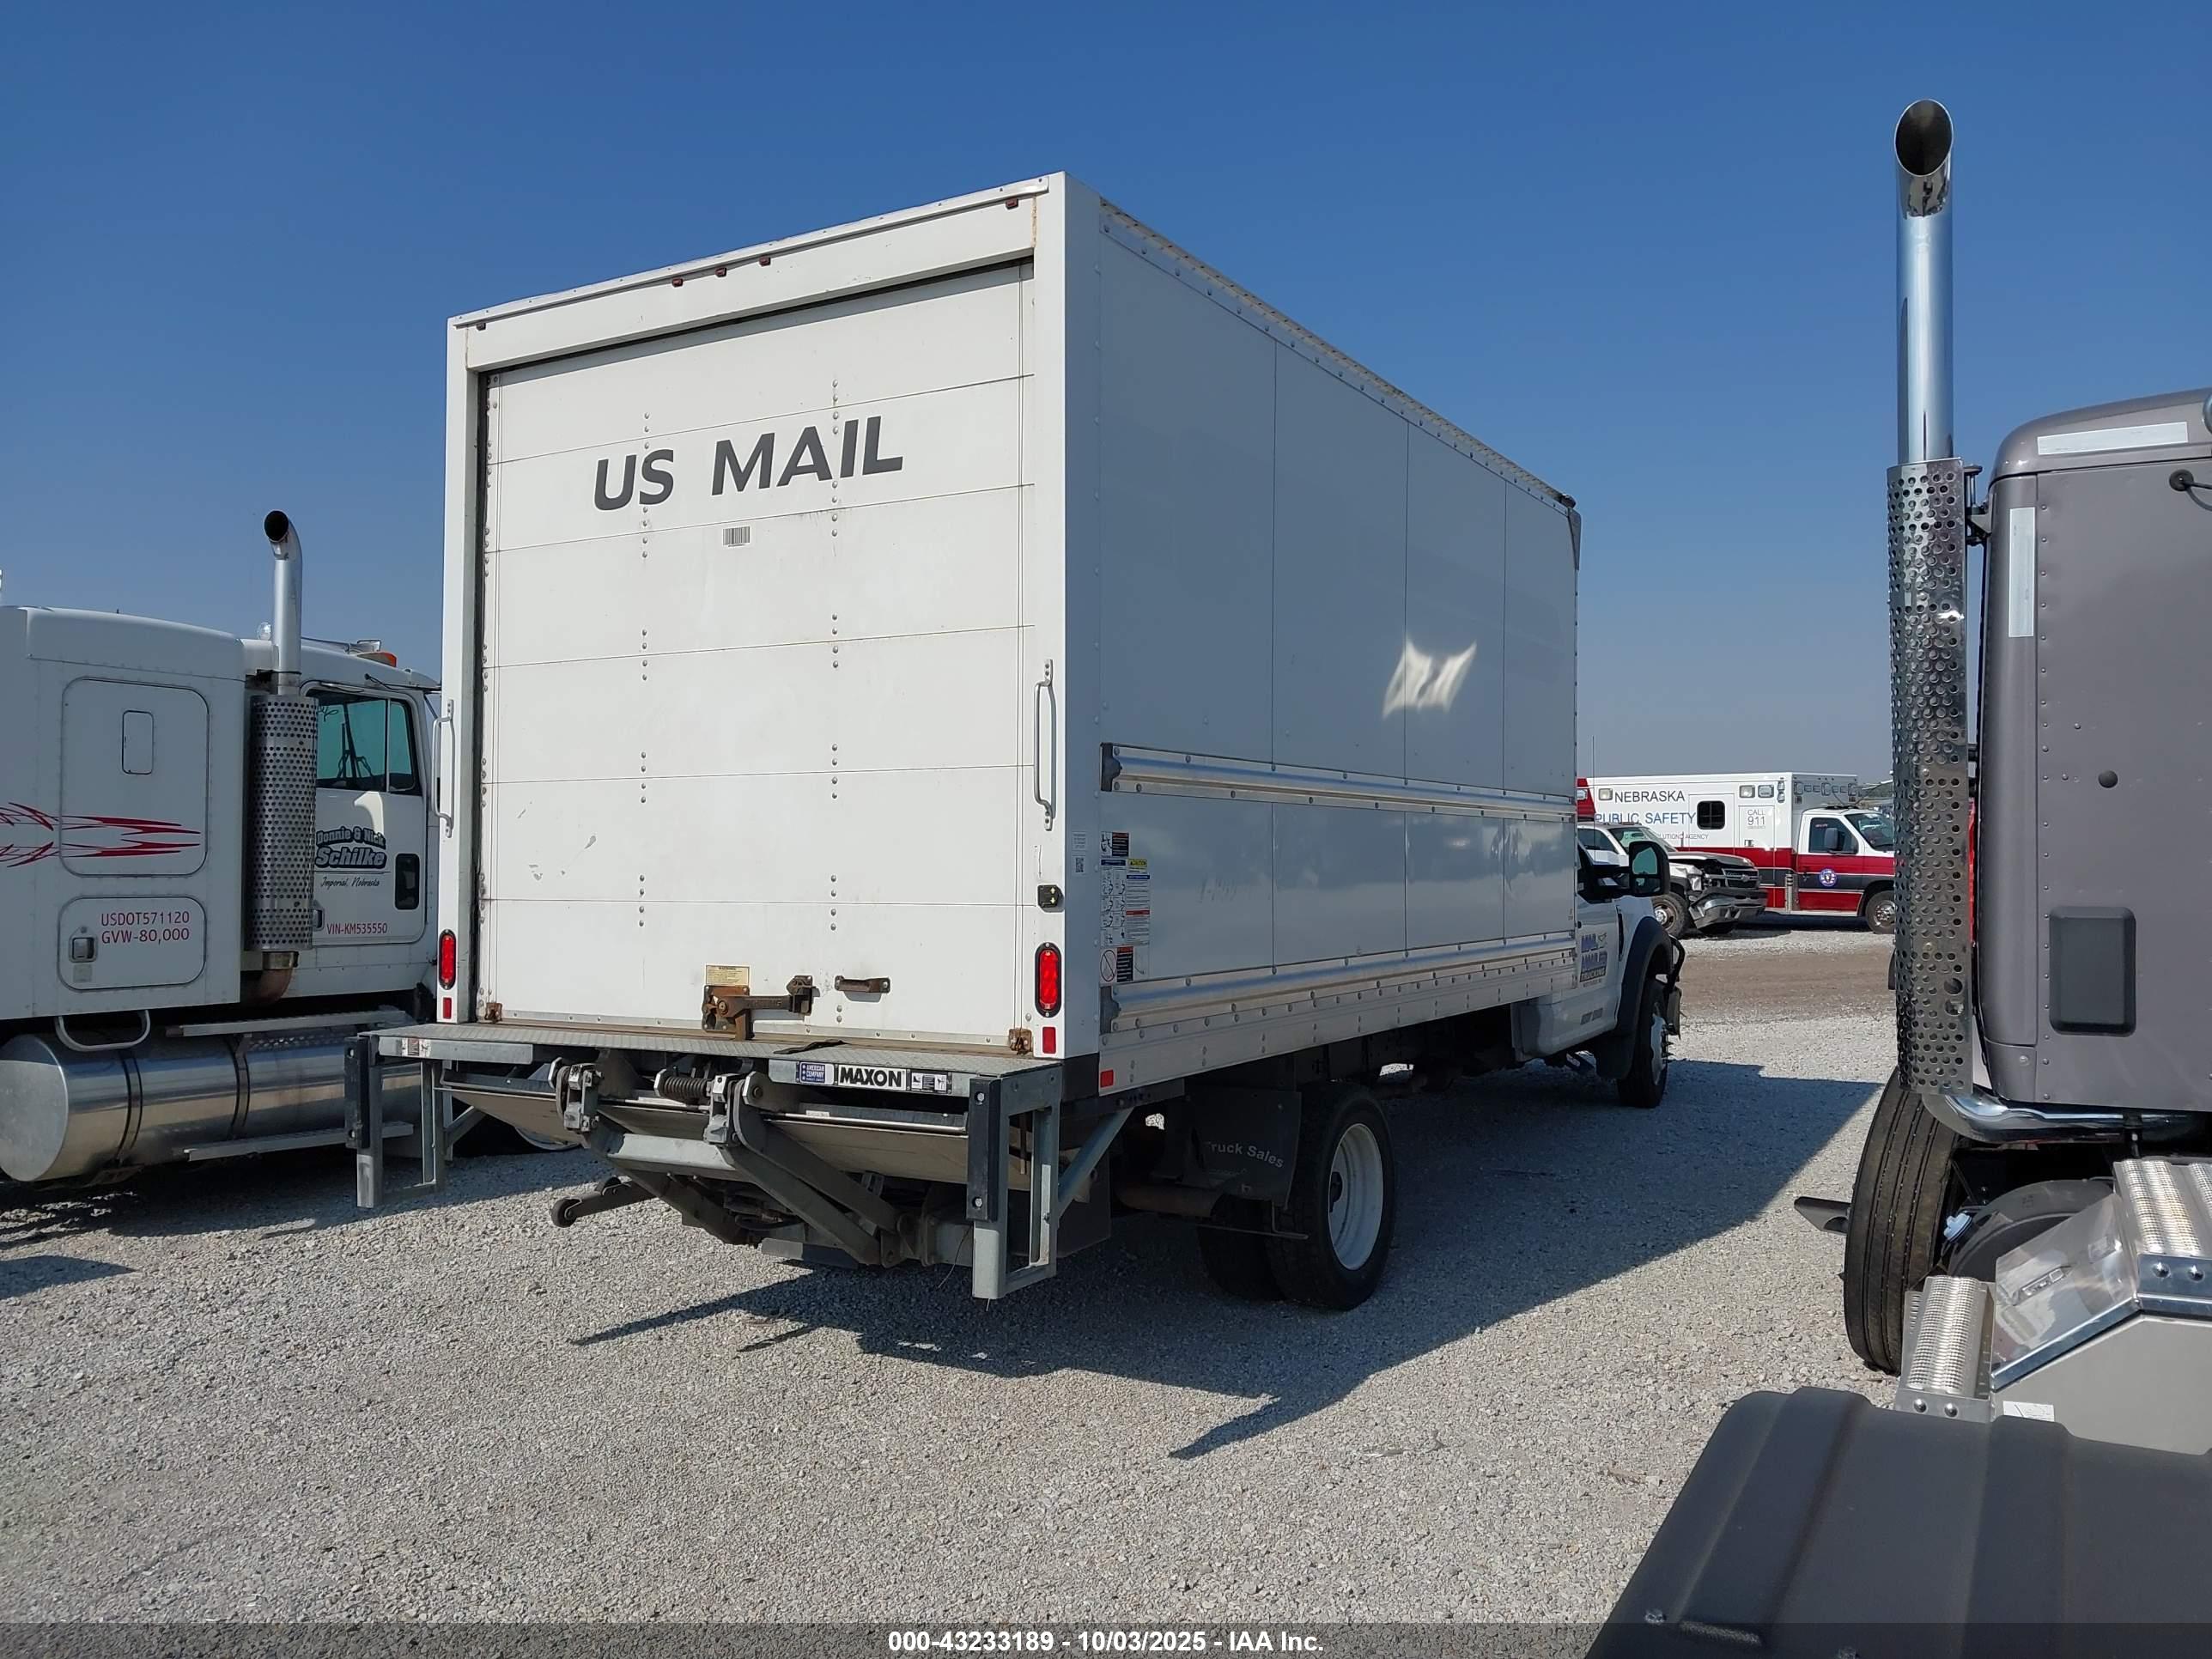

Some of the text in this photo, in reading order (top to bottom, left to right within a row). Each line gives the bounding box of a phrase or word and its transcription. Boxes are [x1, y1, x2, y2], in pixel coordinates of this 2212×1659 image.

[593, 416, 903, 511] US MAIL
[1614, 790, 1686, 803] NEBRASKA
[1595, 811, 1696, 824] PUBLIC SAFETY
[1747, 816, 1765, 825] 911
[316, 826, 386, 849] Donnie & Nick
[315, 846, 387, 869] Schilke
[100, 910, 191, 927] USDOT571120
[101, 927, 191, 945] GVW-80,000
[326, 922, 388, 935] VIN-KM535550
[839, 1066, 902, 1087] MAXON
[1247, 1146, 1285, 1168] Sales
